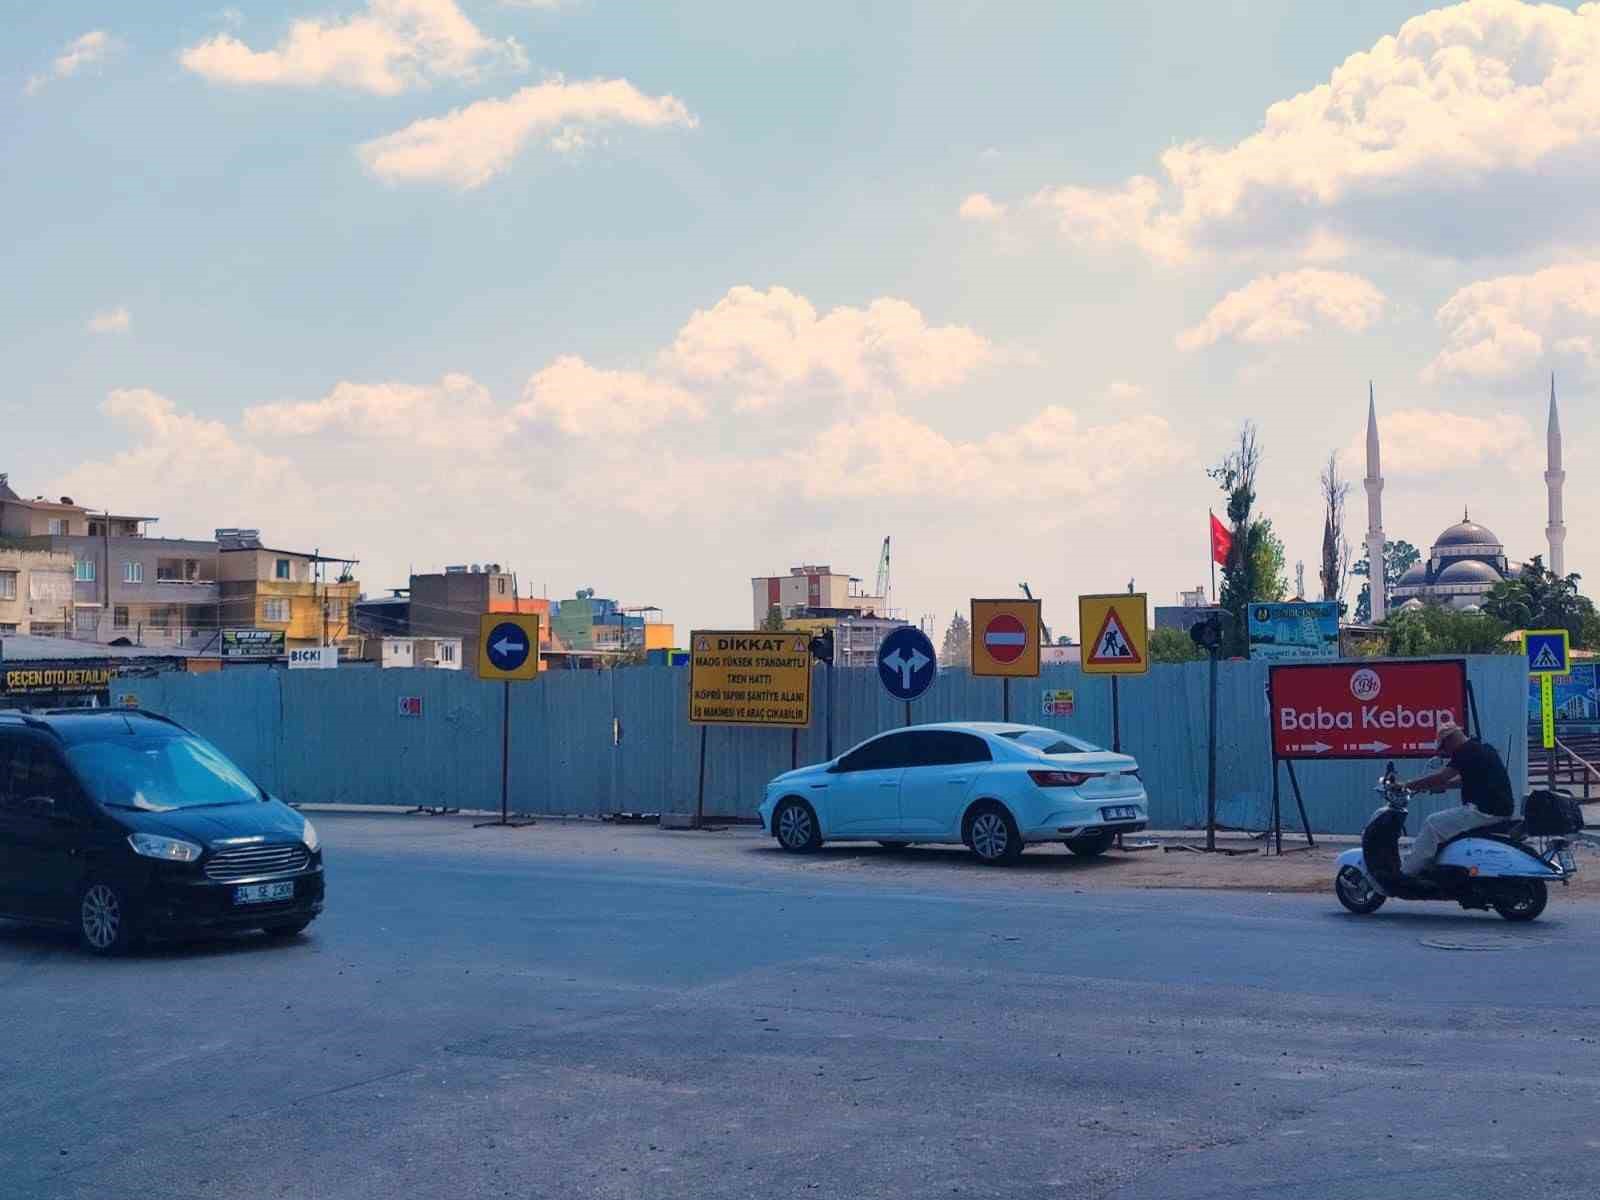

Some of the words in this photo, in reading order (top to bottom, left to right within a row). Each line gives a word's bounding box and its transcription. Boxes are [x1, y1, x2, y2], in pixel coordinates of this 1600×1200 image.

[718, 637, 784, 651] DİKKAT
[44, 670, 65, 685] OTO
[1279, 705, 1353, 730] Baba
[1361, 704, 1455, 729] Kebap
